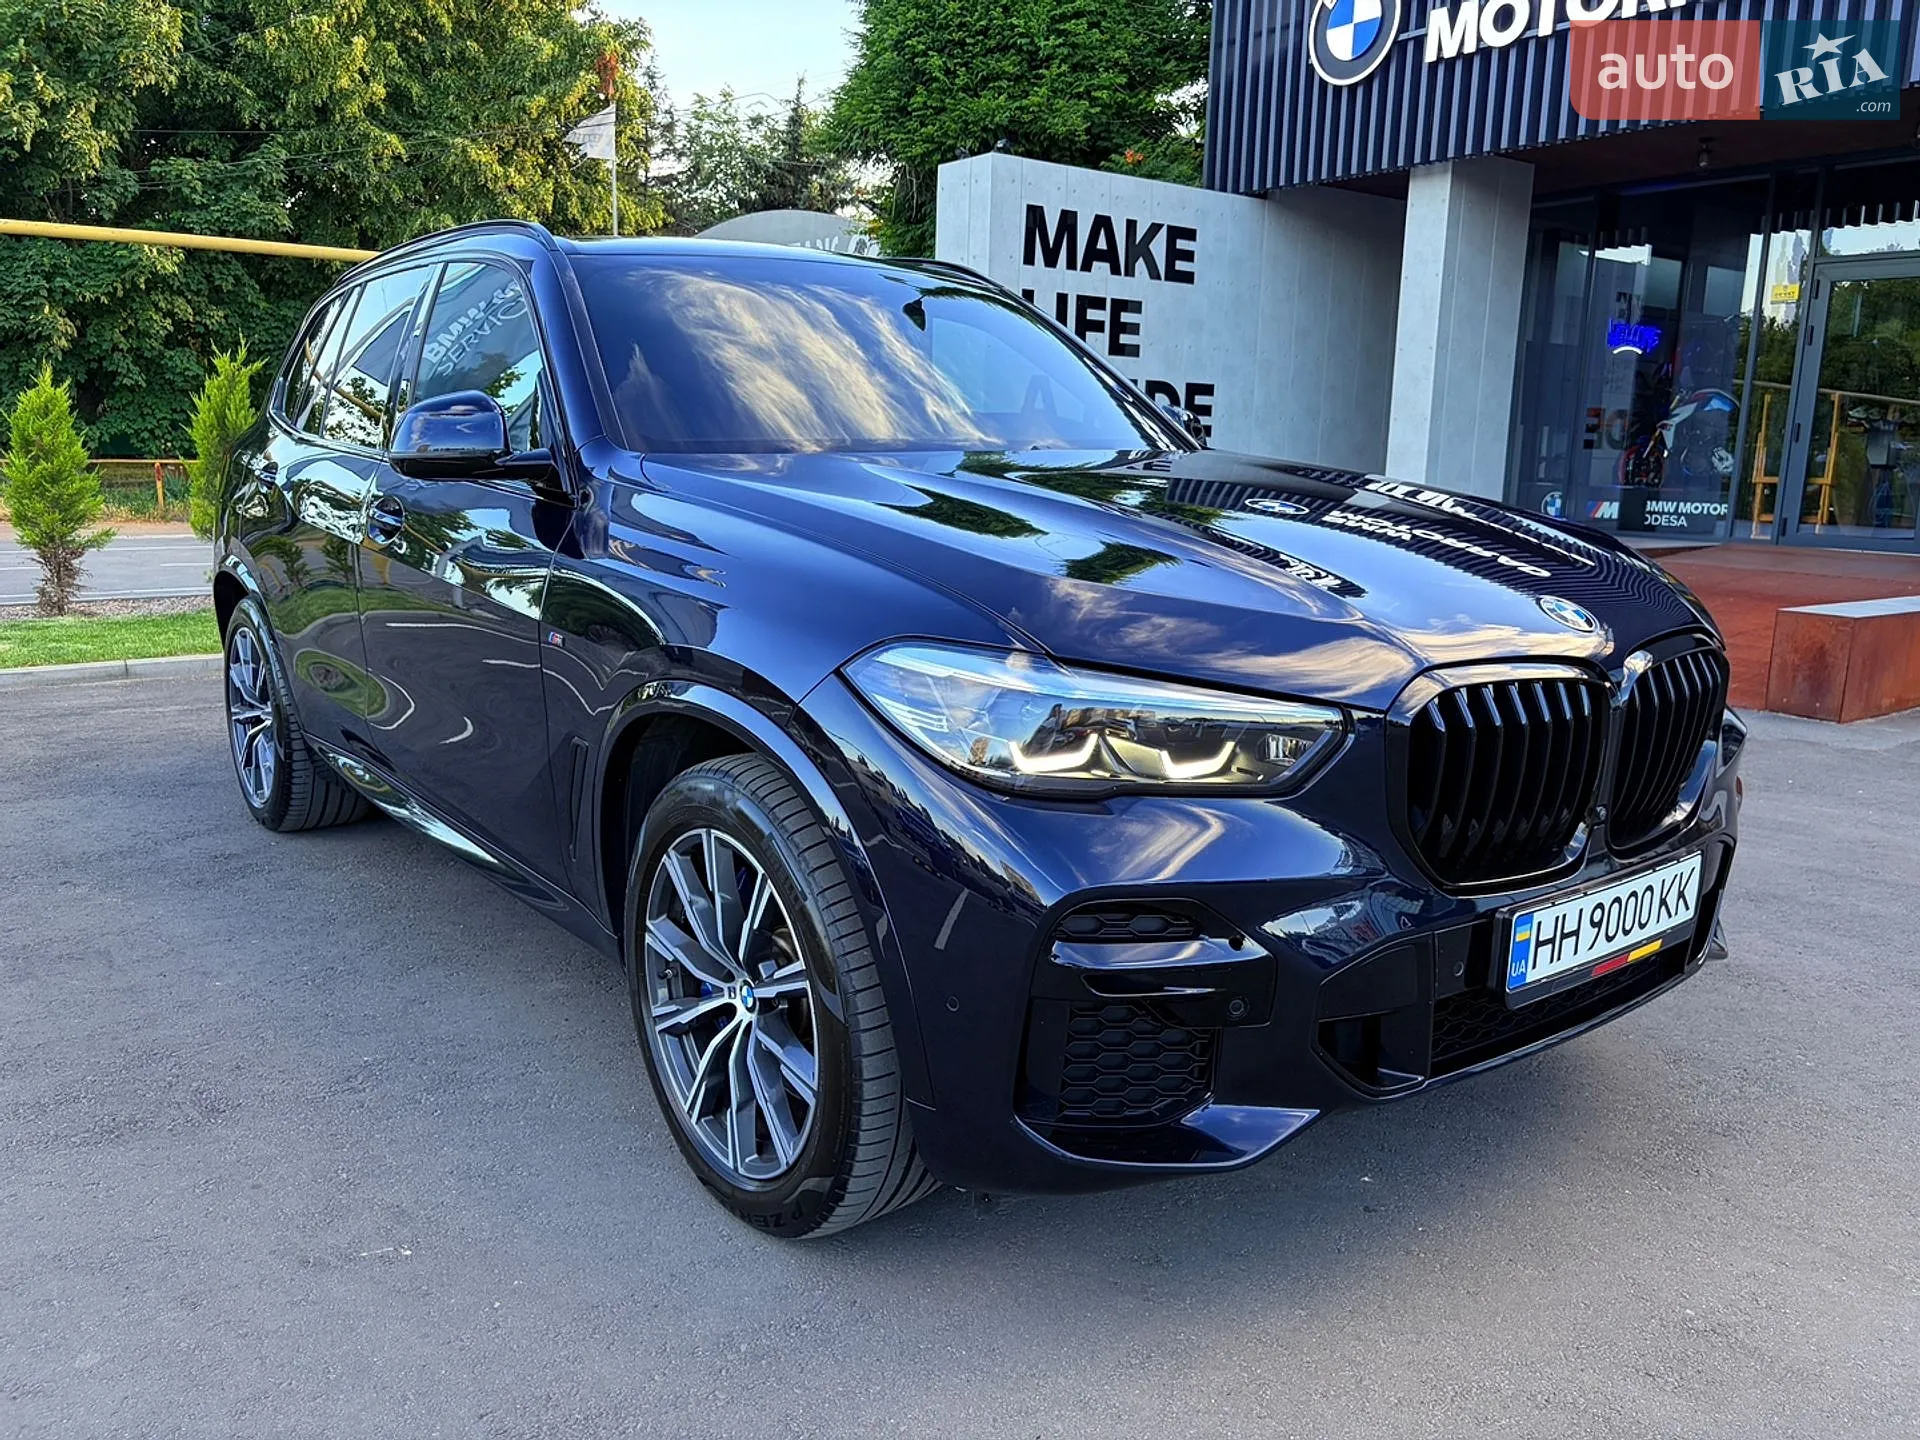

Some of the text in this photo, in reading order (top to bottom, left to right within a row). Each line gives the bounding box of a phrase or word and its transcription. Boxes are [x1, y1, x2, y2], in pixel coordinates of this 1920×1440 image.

[1022, 203, 1198, 285] MAKE
[1022, 289, 1143, 358] IFE
[1531, 866, 1696, 970] HH 9000 KK
[1511, 959, 1527, 978] UA
